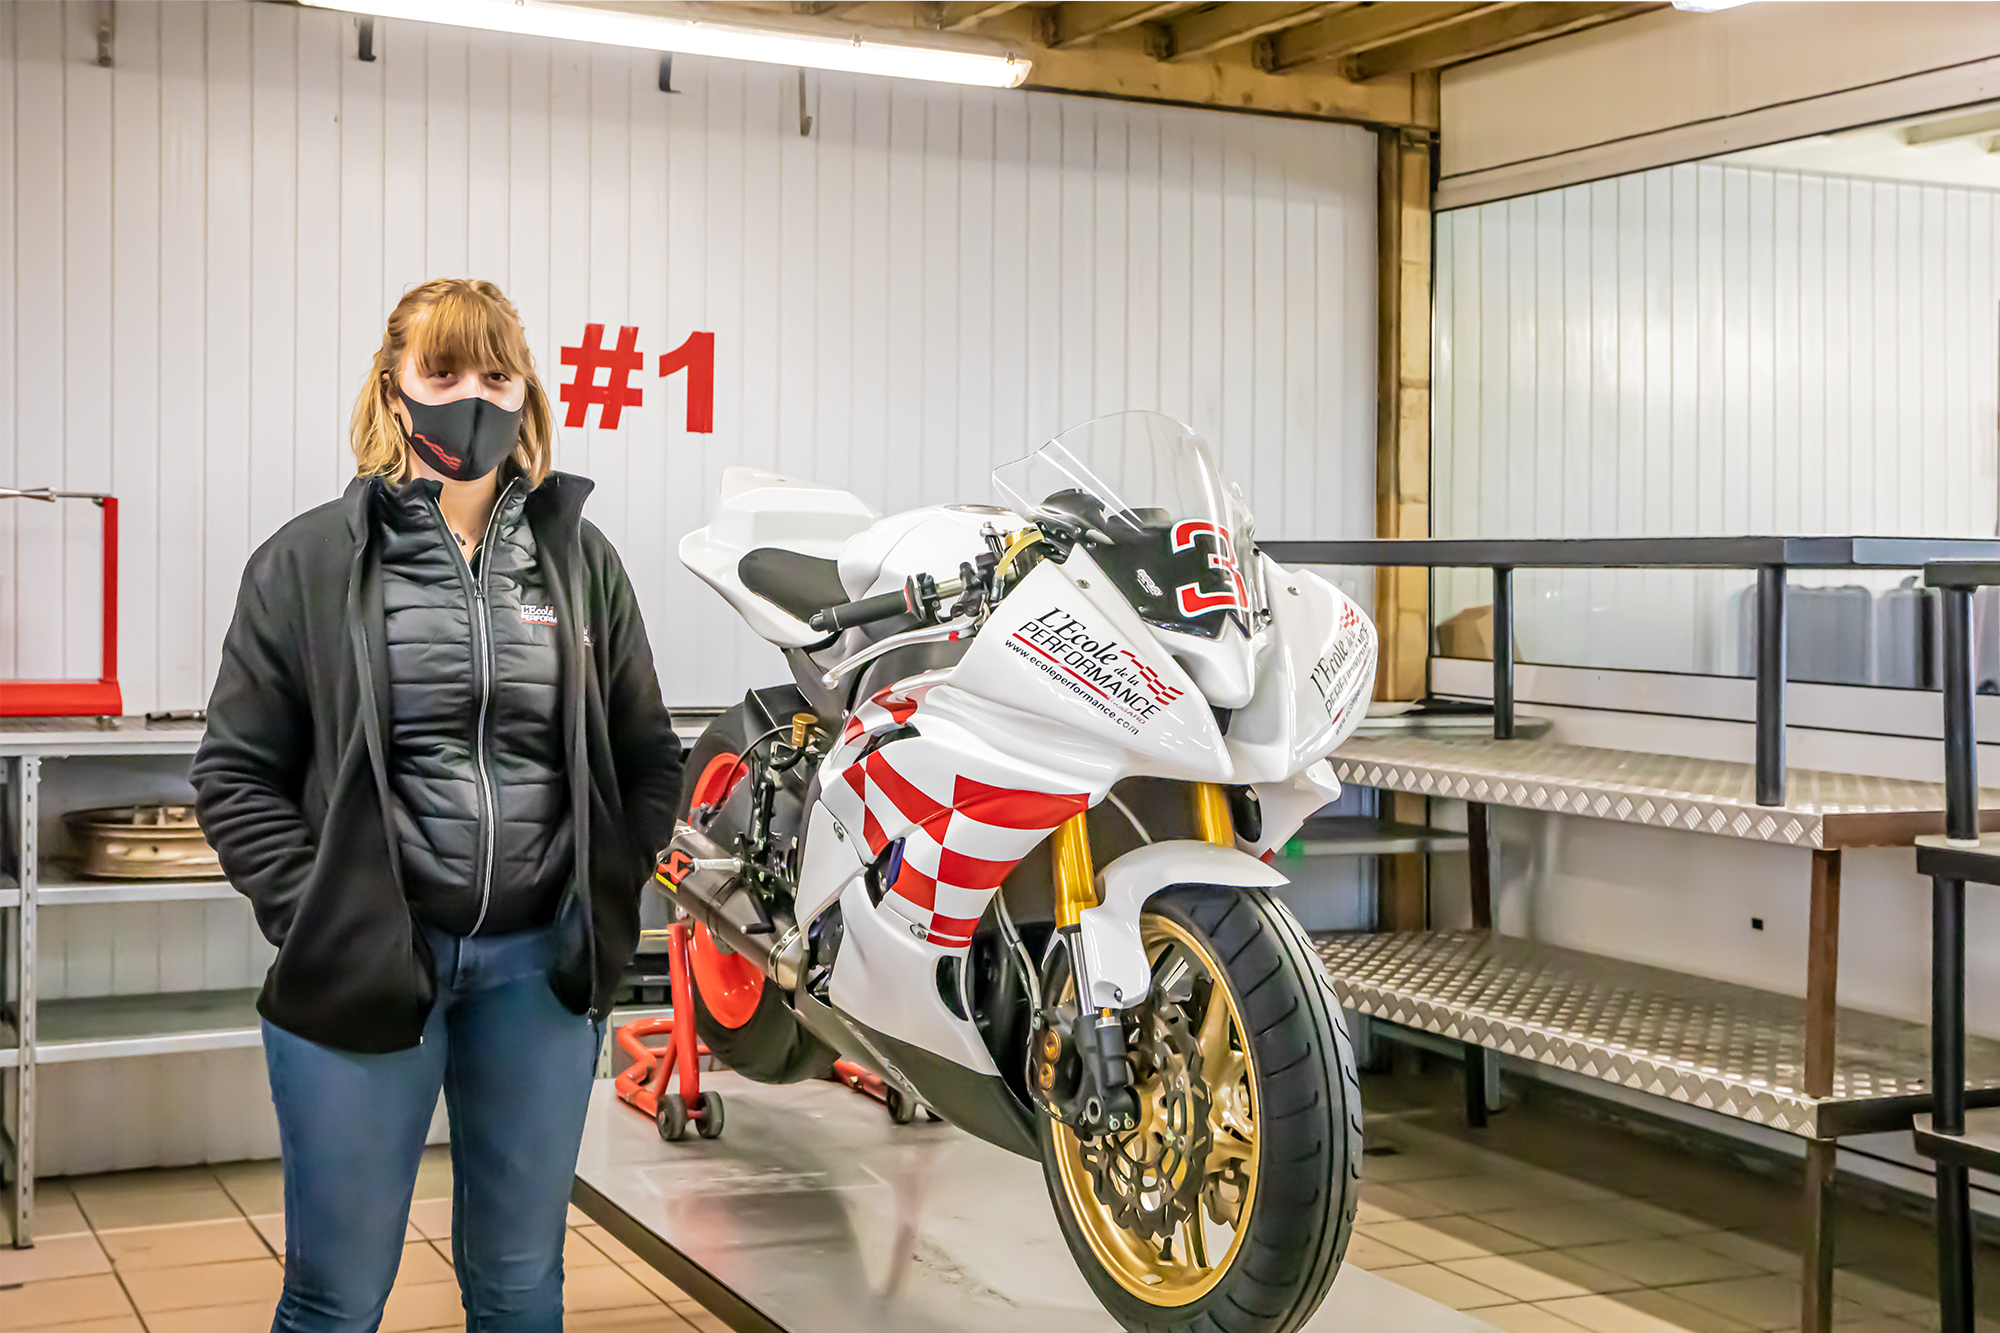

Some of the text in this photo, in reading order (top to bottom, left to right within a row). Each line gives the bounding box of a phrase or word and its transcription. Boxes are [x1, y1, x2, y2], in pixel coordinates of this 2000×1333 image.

[560, 323, 715, 434] #1
[1171, 518, 1250, 618] 3
[1004, 639, 1140, 736] www.ecoleperformance.com
[1018, 621, 1162, 720] PERFORMANCE
[1034, 606, 1140, 687] L'Ecole de la
